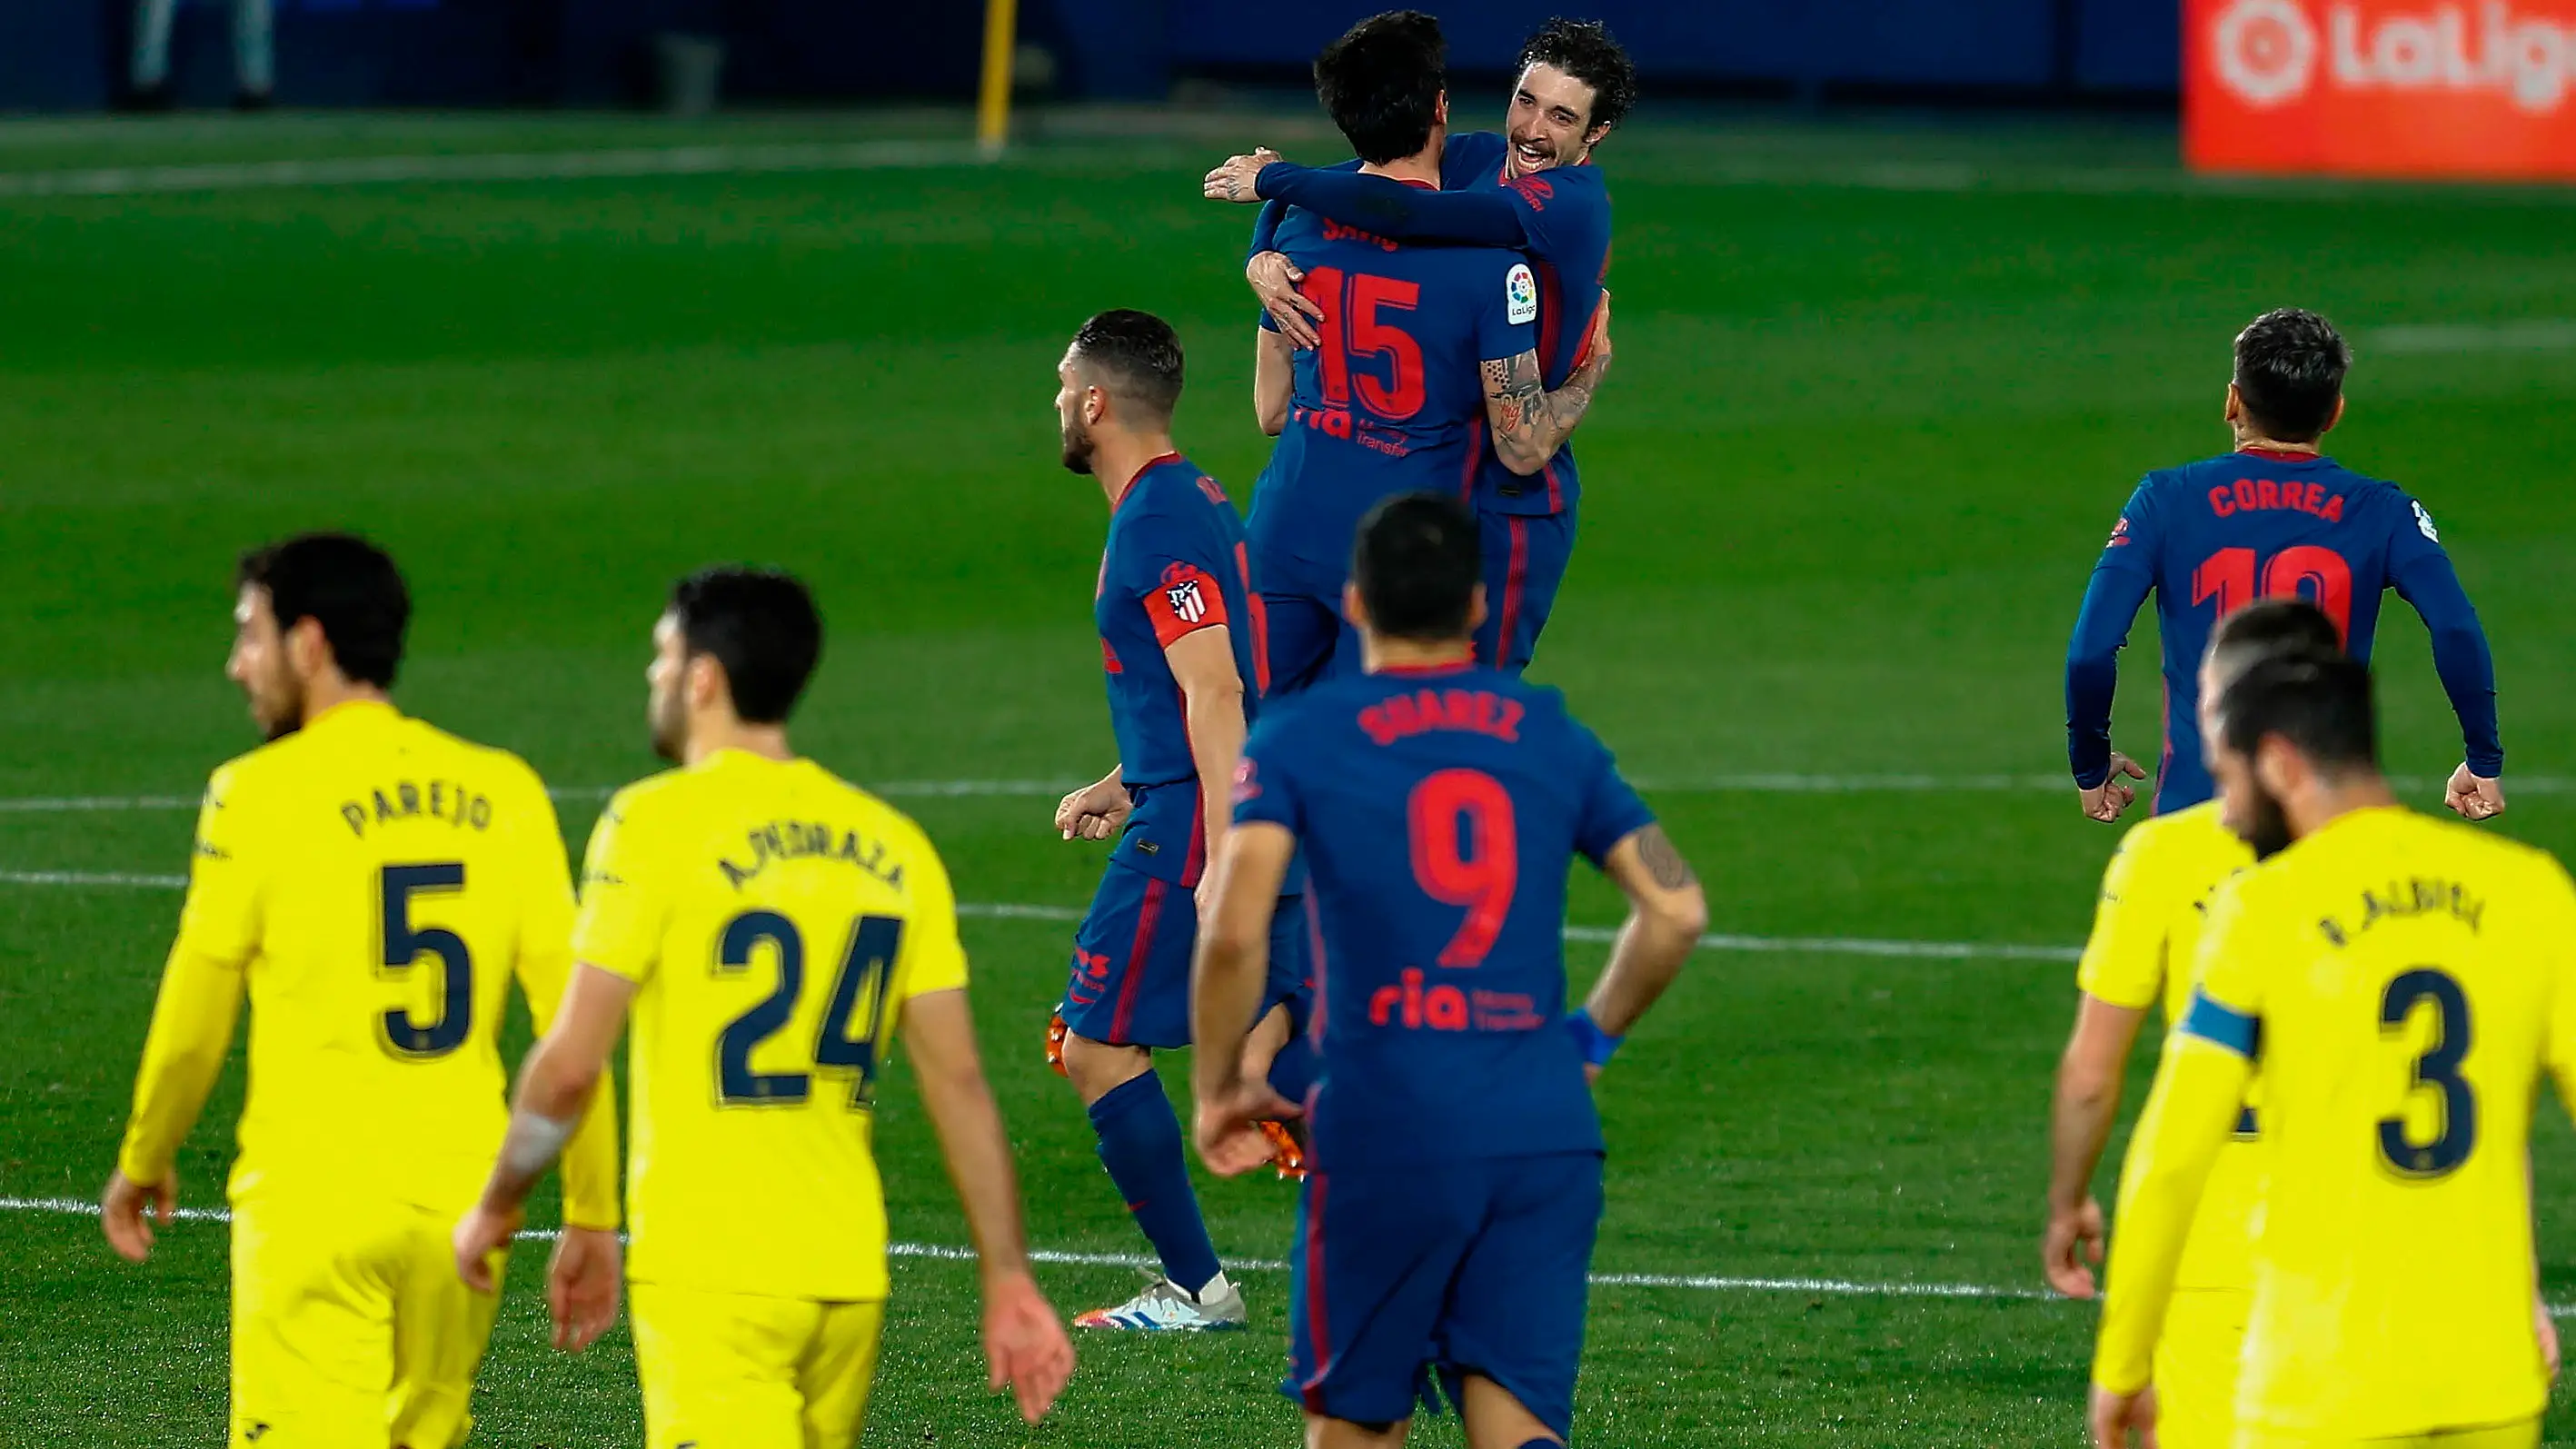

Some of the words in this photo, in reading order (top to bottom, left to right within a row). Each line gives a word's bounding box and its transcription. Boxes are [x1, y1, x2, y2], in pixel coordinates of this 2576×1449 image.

[2330, 1, 2576, 113] LaLig
[1299, 265, 1425, 419] 15
[2209, 479, 2345, 523] CORREA
[1358, 689, 1526, 746] SUAREZ
[341, 779, 492, 839] PAREJO
[1407, 769, 1517, 968] 9
[374, 862, 472, 1057] 5
[711, 909, 905, 1111] 24
[1368, 967, 1468, 1030] ria
[2376, 967, 2478, 1181] 3
